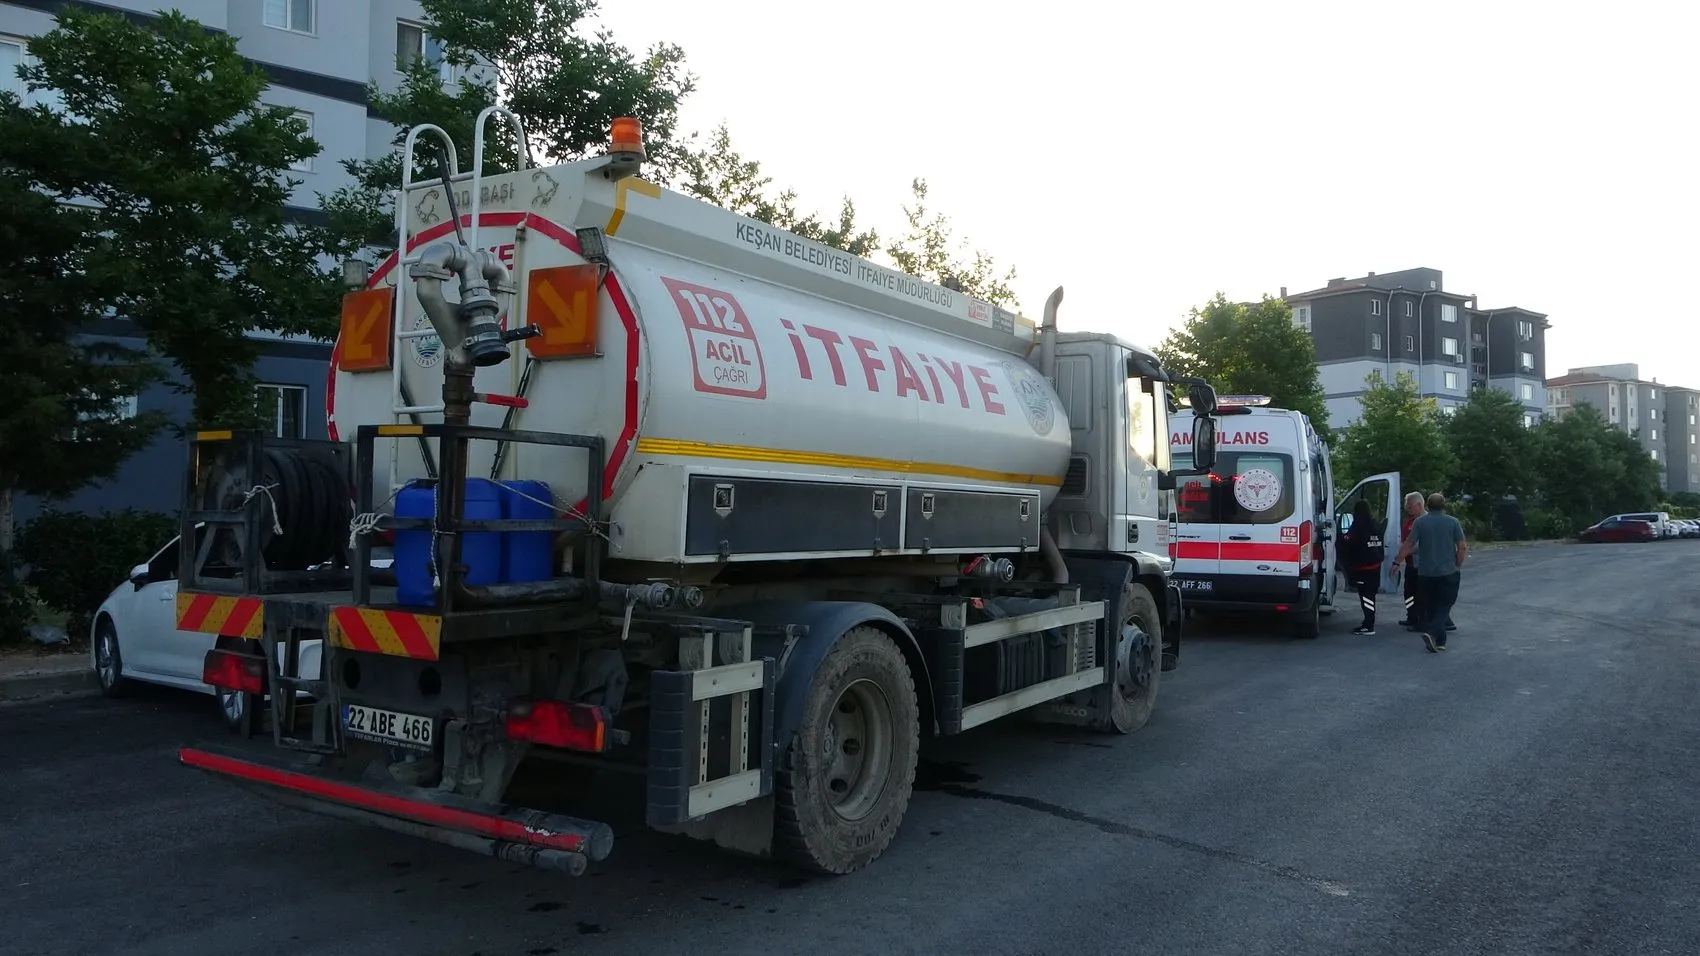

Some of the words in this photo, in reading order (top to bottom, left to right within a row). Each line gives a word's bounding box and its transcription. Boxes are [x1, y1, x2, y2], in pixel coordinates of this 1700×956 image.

[735, 222, 782, 252] KEŞAN
[785, 239, 853, 276] BELEDİYESİ
[857, 261, 895, 291] İTFAİYE
[896, 278, 953, 308] MÜDÜRLÜĞÜ
[678, 289, 744, 334] 112
[705, 338, 752, 366] ACİL
[713, 365, 749, 385] ÇAĞRI
[779, 318, 1006, 416] İTFAİYE
[1170, 431, 1269, 445] AMLANS
[1283, 528, 1296, 537] 112
[1181, 580, 1195, 589] AFF
[1197, 581, 1211, 590] 266
[348, 707, 365, 730] 22
[370, 711, 397, 737] ABE
[402, 716, 431, 742] 466
